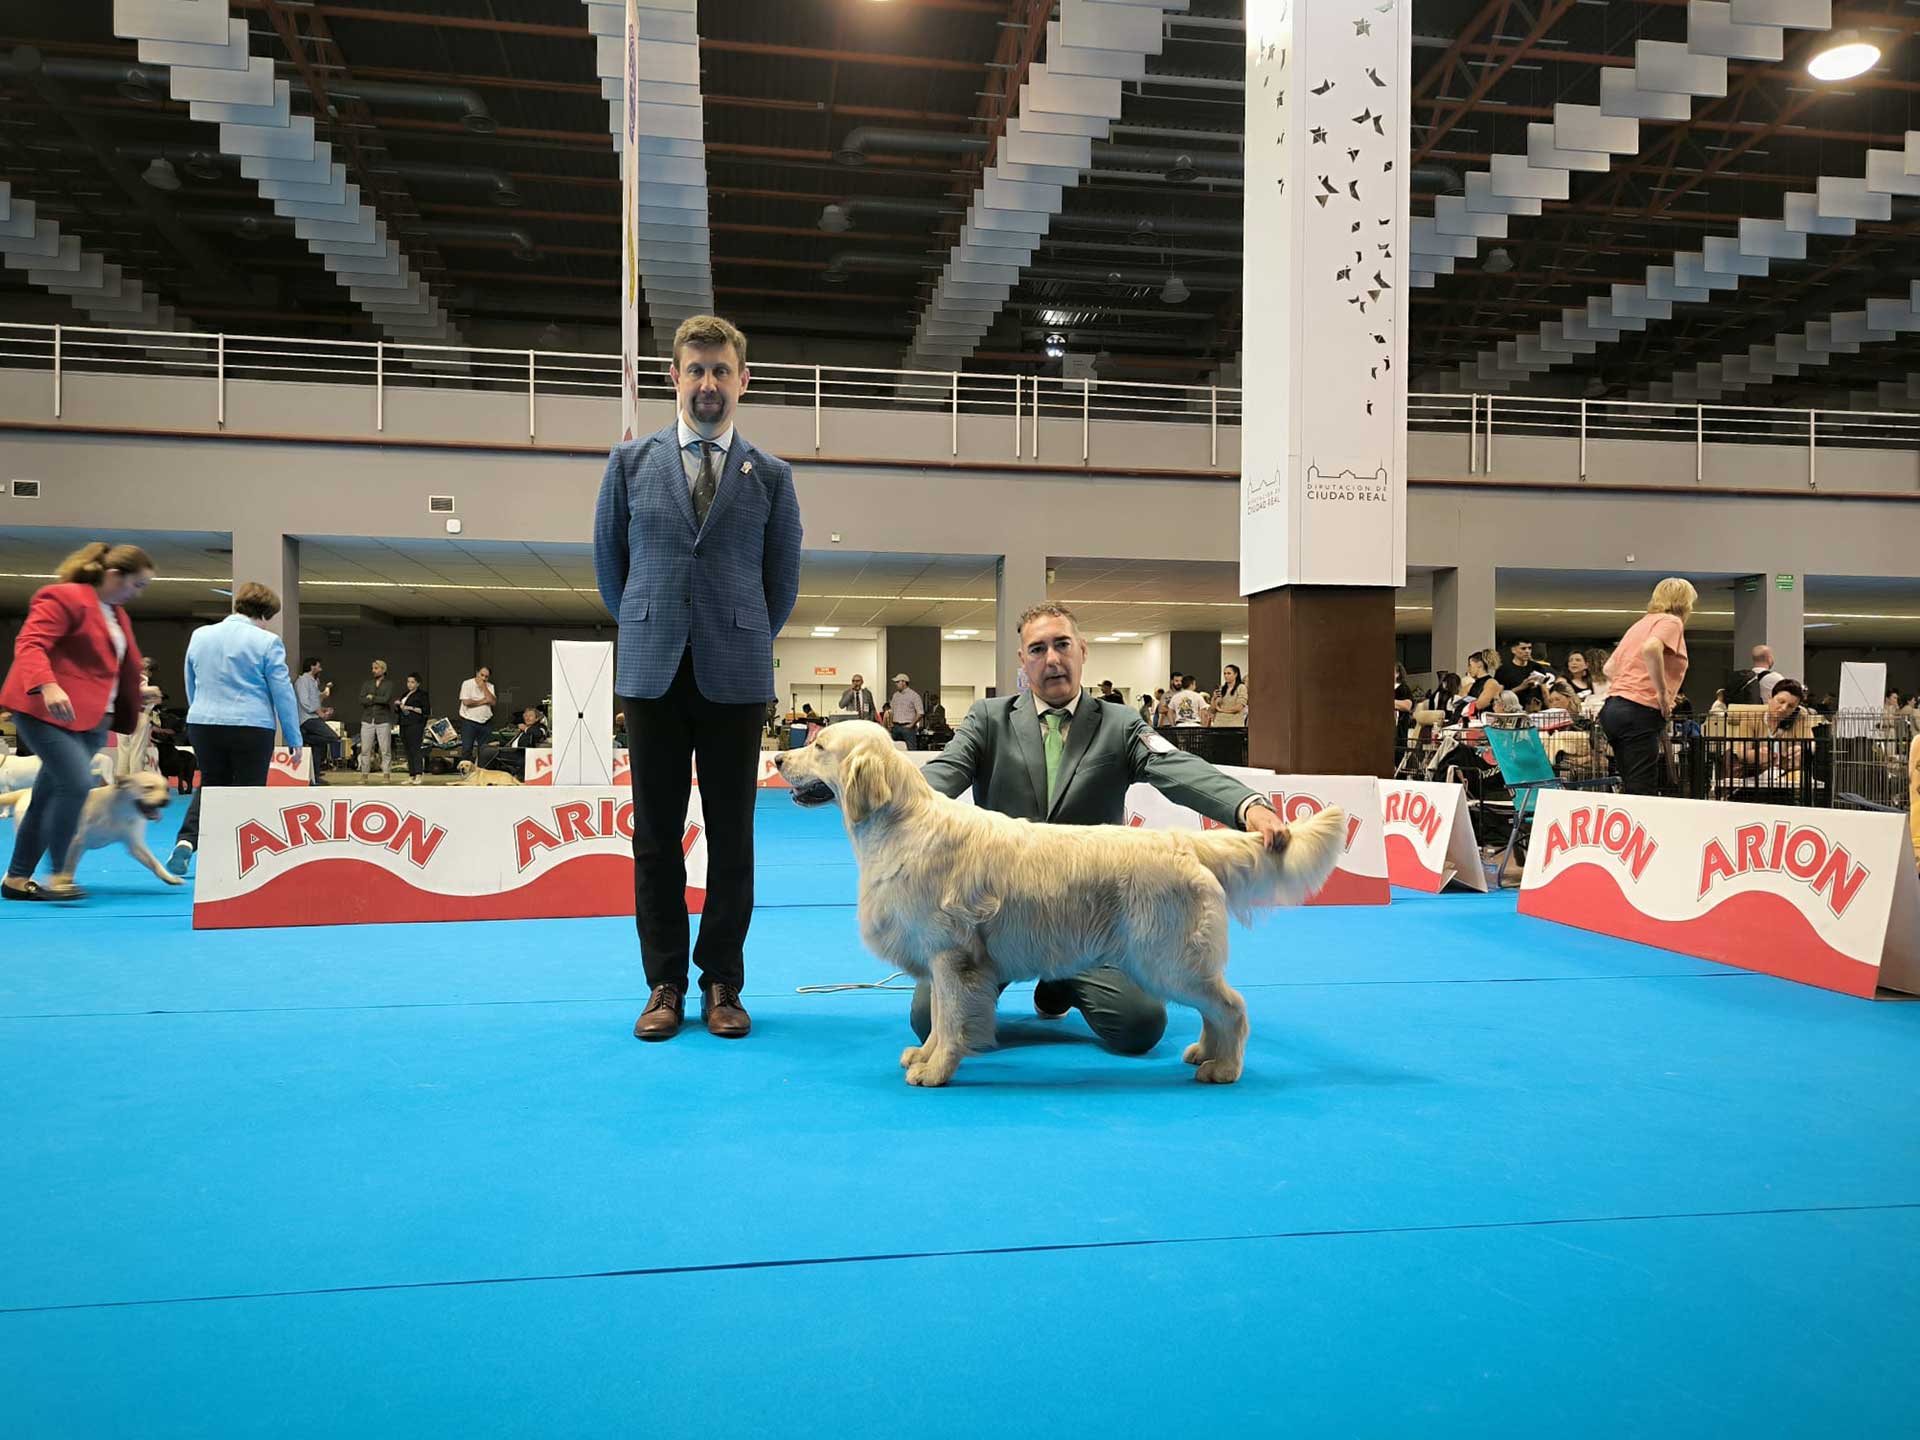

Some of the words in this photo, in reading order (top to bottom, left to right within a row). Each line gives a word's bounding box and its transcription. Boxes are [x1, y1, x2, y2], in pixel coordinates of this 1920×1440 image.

[1307, 490, 1355, 500] CIUDAD
[1358, 492, 1388, 502] REAL
[236, 799, 448, 879] ARION
[1383, 790, 1442, 848] RION
[1542, 805, 1658, 883] ARION
[1697, 821, 1870, 919] ARION
